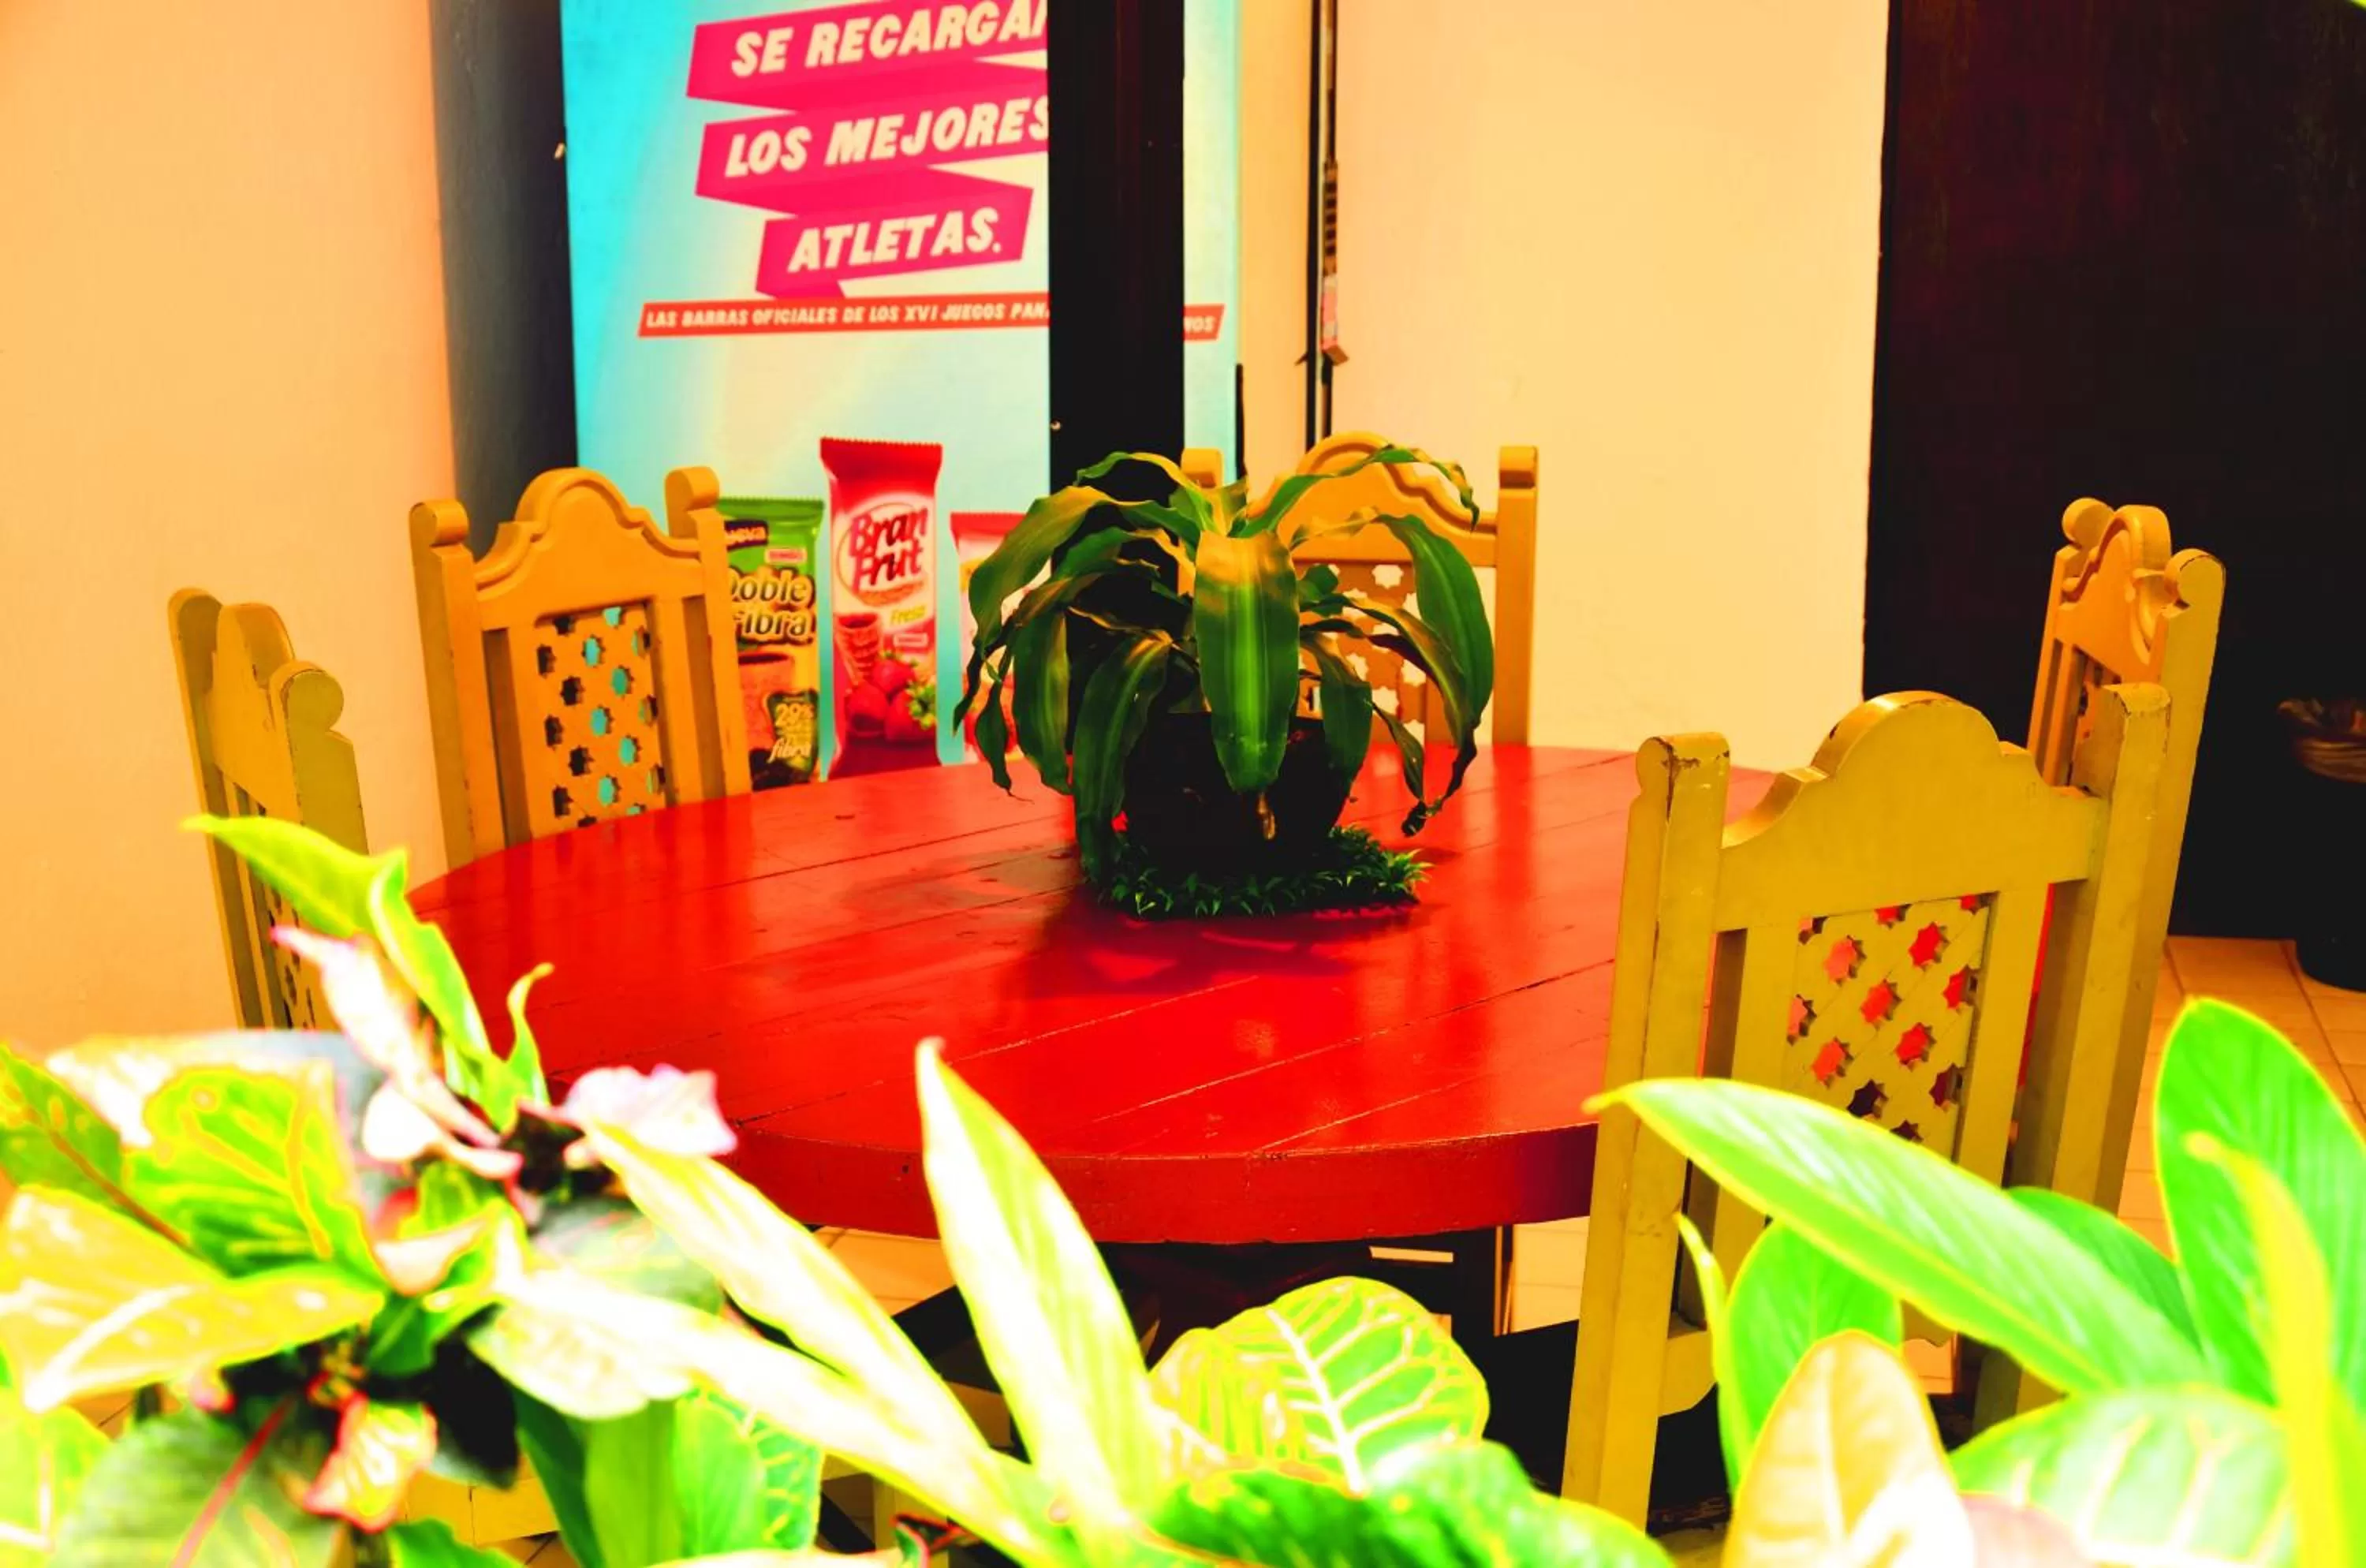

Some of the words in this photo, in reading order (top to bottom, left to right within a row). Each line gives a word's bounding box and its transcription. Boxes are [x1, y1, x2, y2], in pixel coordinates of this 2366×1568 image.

[731, 27, 794, 78] SE
[725, 125, 812, 177] LOS
[823, 95, 1049, 166] MEJORES
[787, 207, 1002, 273] ATLETAS.
[646, 309, 677, 328] LAS
[681, 308, 748, 327] BARRAS
[752, 306, 838, 326] OFICIALES
[842, 305, 865, 324] DE
[869, 304, 900, 323] LOS
[904, 304, 939, 322] XVI
[942, 302, 1006, 321] JUEGOS
[1010, 301, 1050, 320] PAN
[849, 507, 929, 558] Bran
[851, 538, 924, 593] Frut
